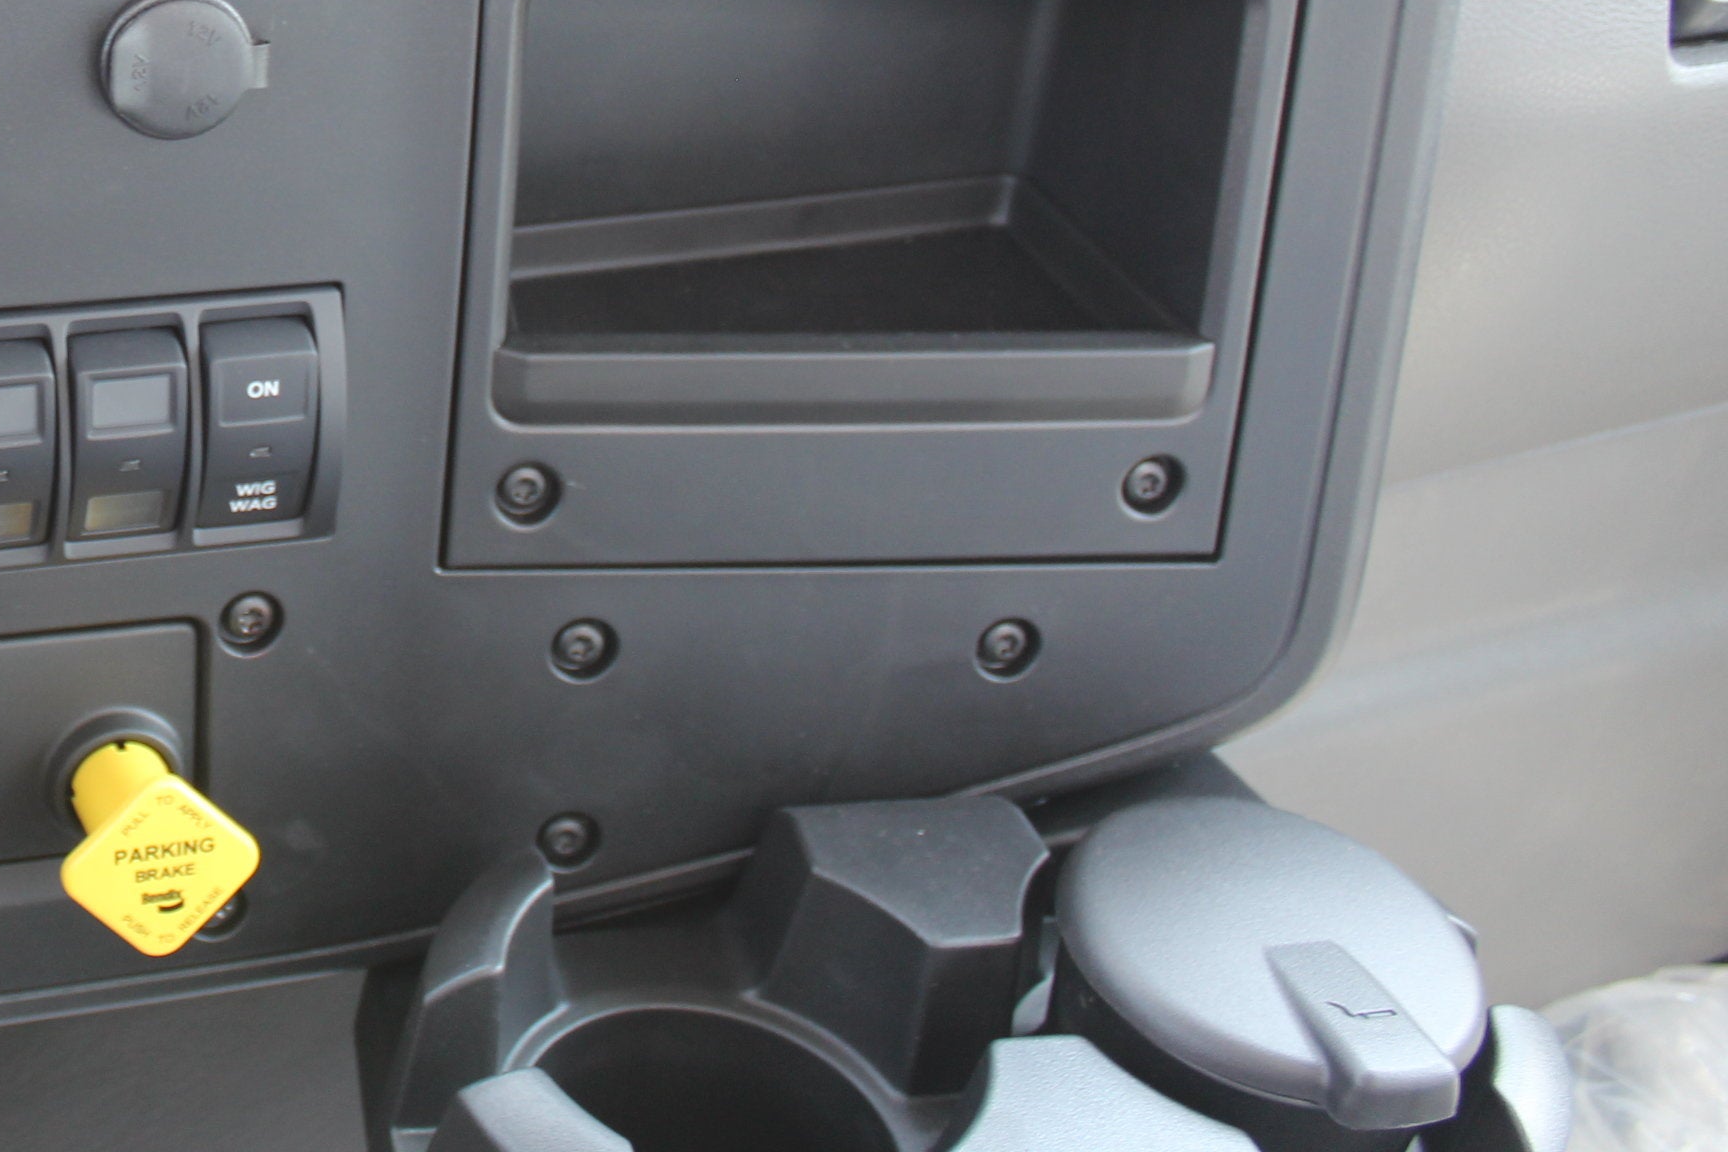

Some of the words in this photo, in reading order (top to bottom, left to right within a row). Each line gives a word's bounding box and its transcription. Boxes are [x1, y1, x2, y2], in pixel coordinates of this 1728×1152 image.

[247, 381, 279, 398] ON
[236, 481, 275, 496] WIG
[230, 497, 276, 512] WAG
[121, 811, 149, 836] PULL
[156, 795, 174, 806] TO
[179, 804, 213, 829] APPLY
[114, 837, 214, 865] PARKING
[135, 863, 195, 883] BRAKE
[123, 915, 150, 937] PUSH
[158, 934, 175, 944] TO
[178, 887, 222, 932] RELEASE
